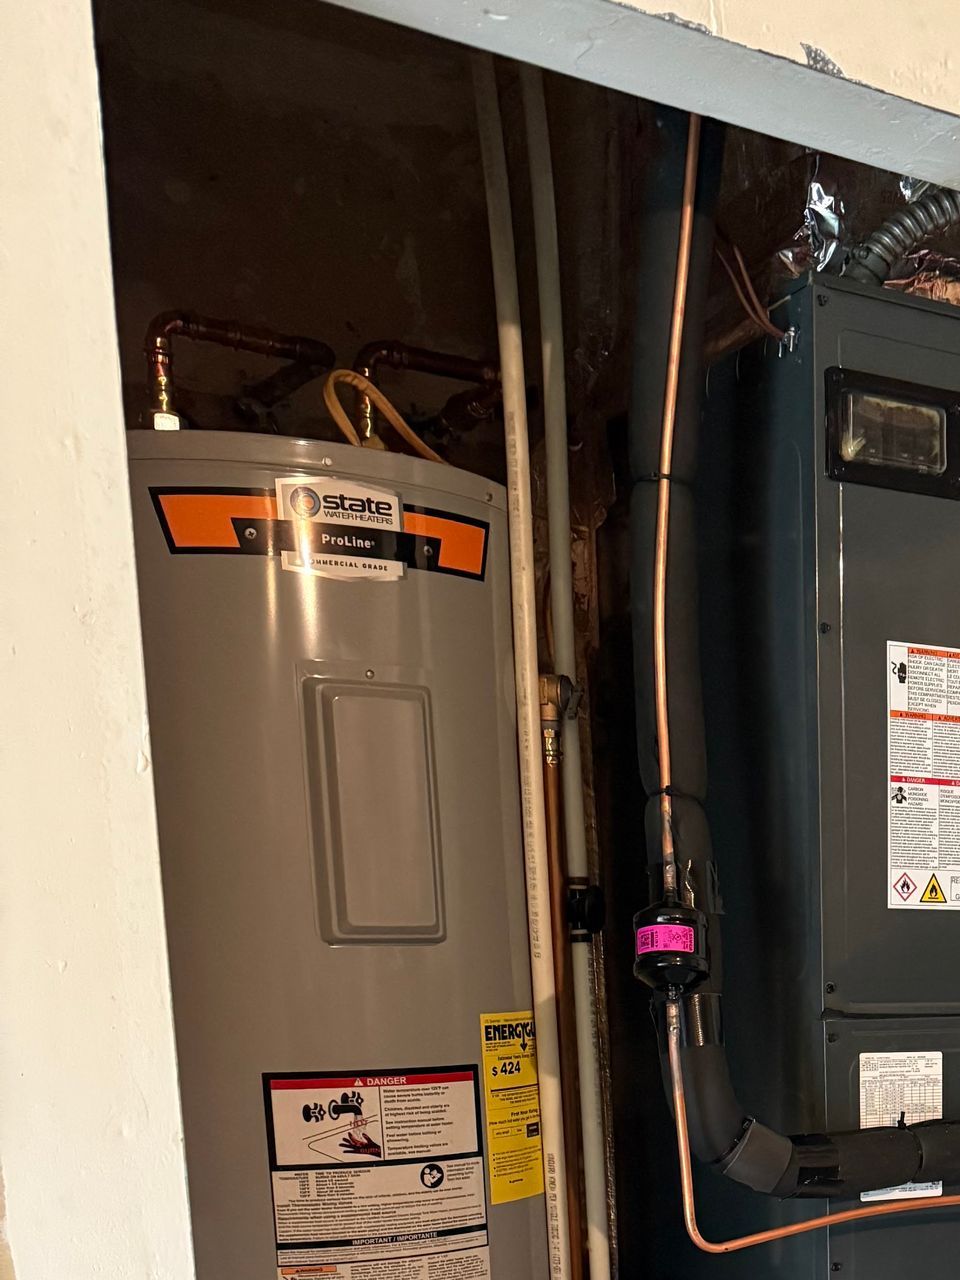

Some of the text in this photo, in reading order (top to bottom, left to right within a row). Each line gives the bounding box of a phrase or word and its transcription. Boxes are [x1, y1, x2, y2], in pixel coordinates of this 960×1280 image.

[322, 494, 392, 517] state
[323, 510, 393, 525] WATER HEATERS
[362, 561, 388, 571] GRADE
[501, 1061, 520, 1075] 424
[367, 1077, 407, 1086] DANGER
[352, 1236, 393, 1246] IMPORTANT
[397, 1232, 438, 1242] IMPORTANTE
